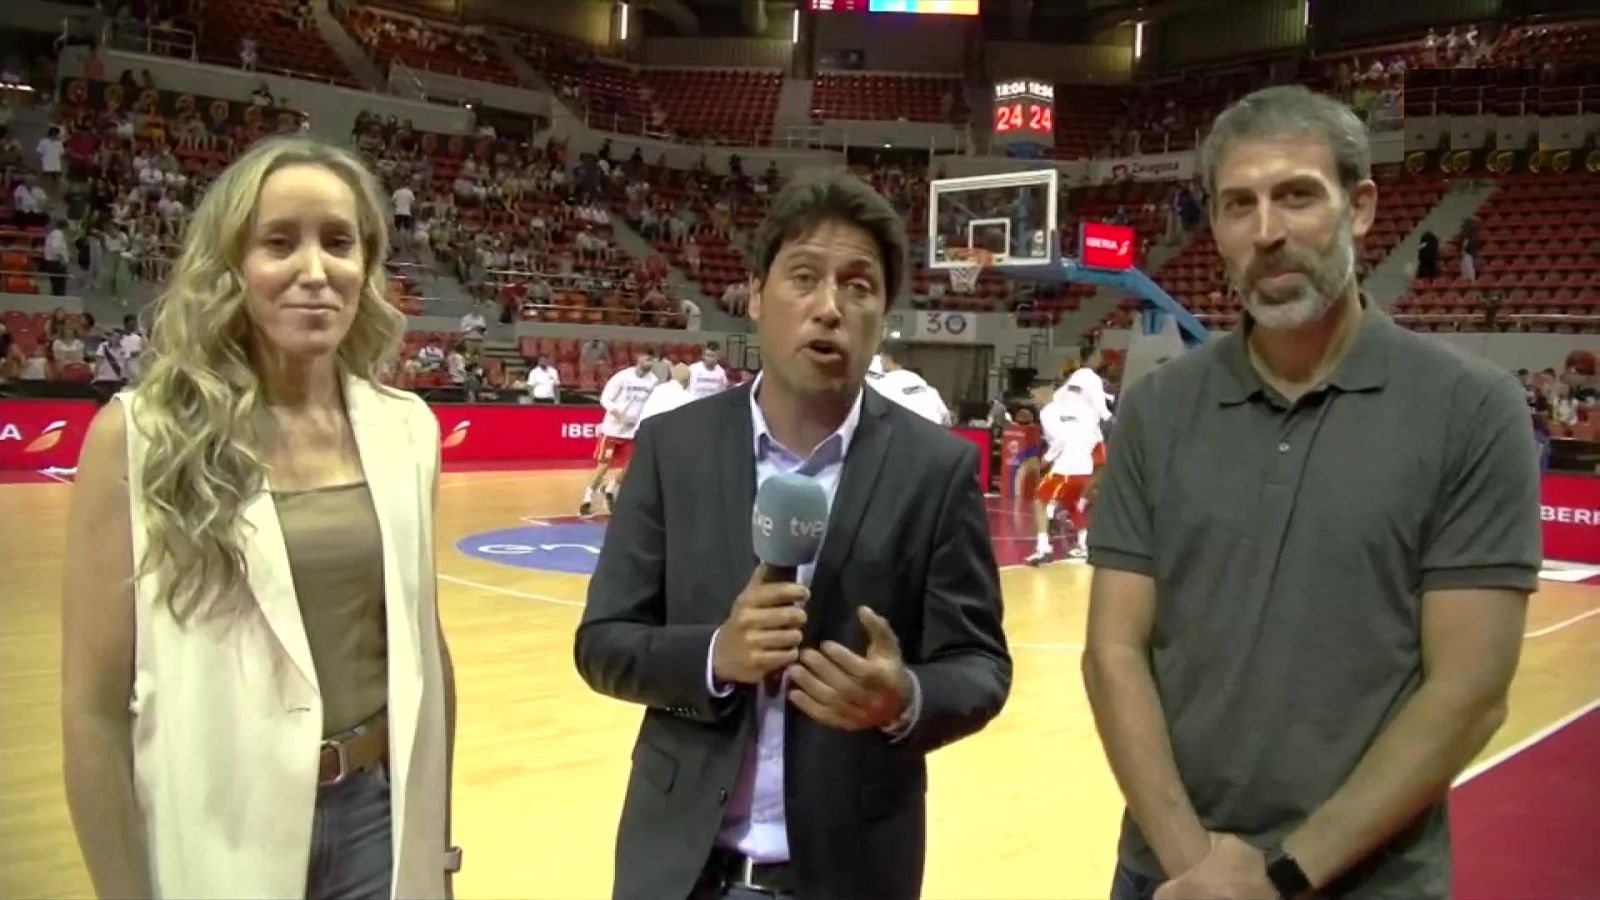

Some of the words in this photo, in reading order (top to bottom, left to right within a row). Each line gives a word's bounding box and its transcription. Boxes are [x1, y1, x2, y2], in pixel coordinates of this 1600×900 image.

[996, 104, 1023, 131] 24
[1029, 104, 1052, 131] 24
[1086, 236, 1118, 250] IBERIA
[925, 313, 967, 335] 30
[789, 517, 825, 538] tve
